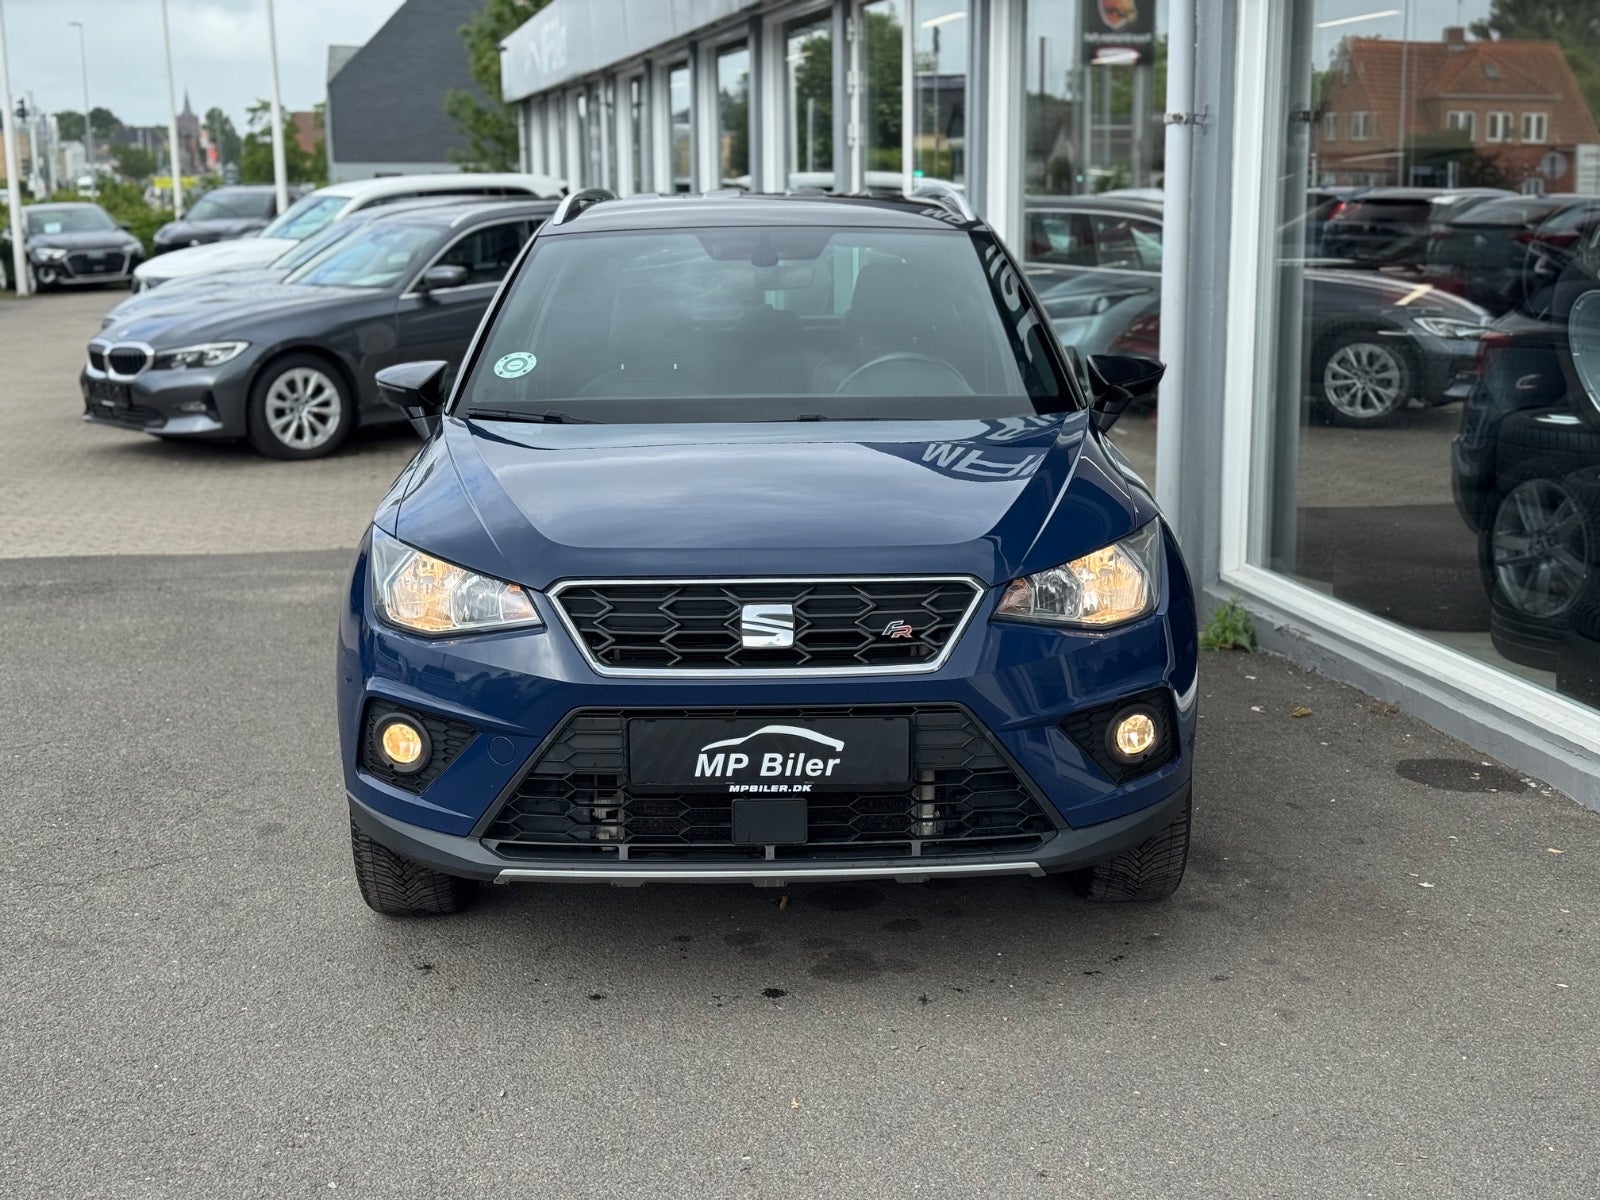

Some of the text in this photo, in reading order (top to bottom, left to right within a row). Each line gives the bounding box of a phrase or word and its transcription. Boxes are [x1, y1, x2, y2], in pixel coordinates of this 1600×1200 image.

[882, 620, 913, 638] FR
[694, 752, 841, 777] MP Biler
[728, 784, 813, 793] MPBILER.DK
